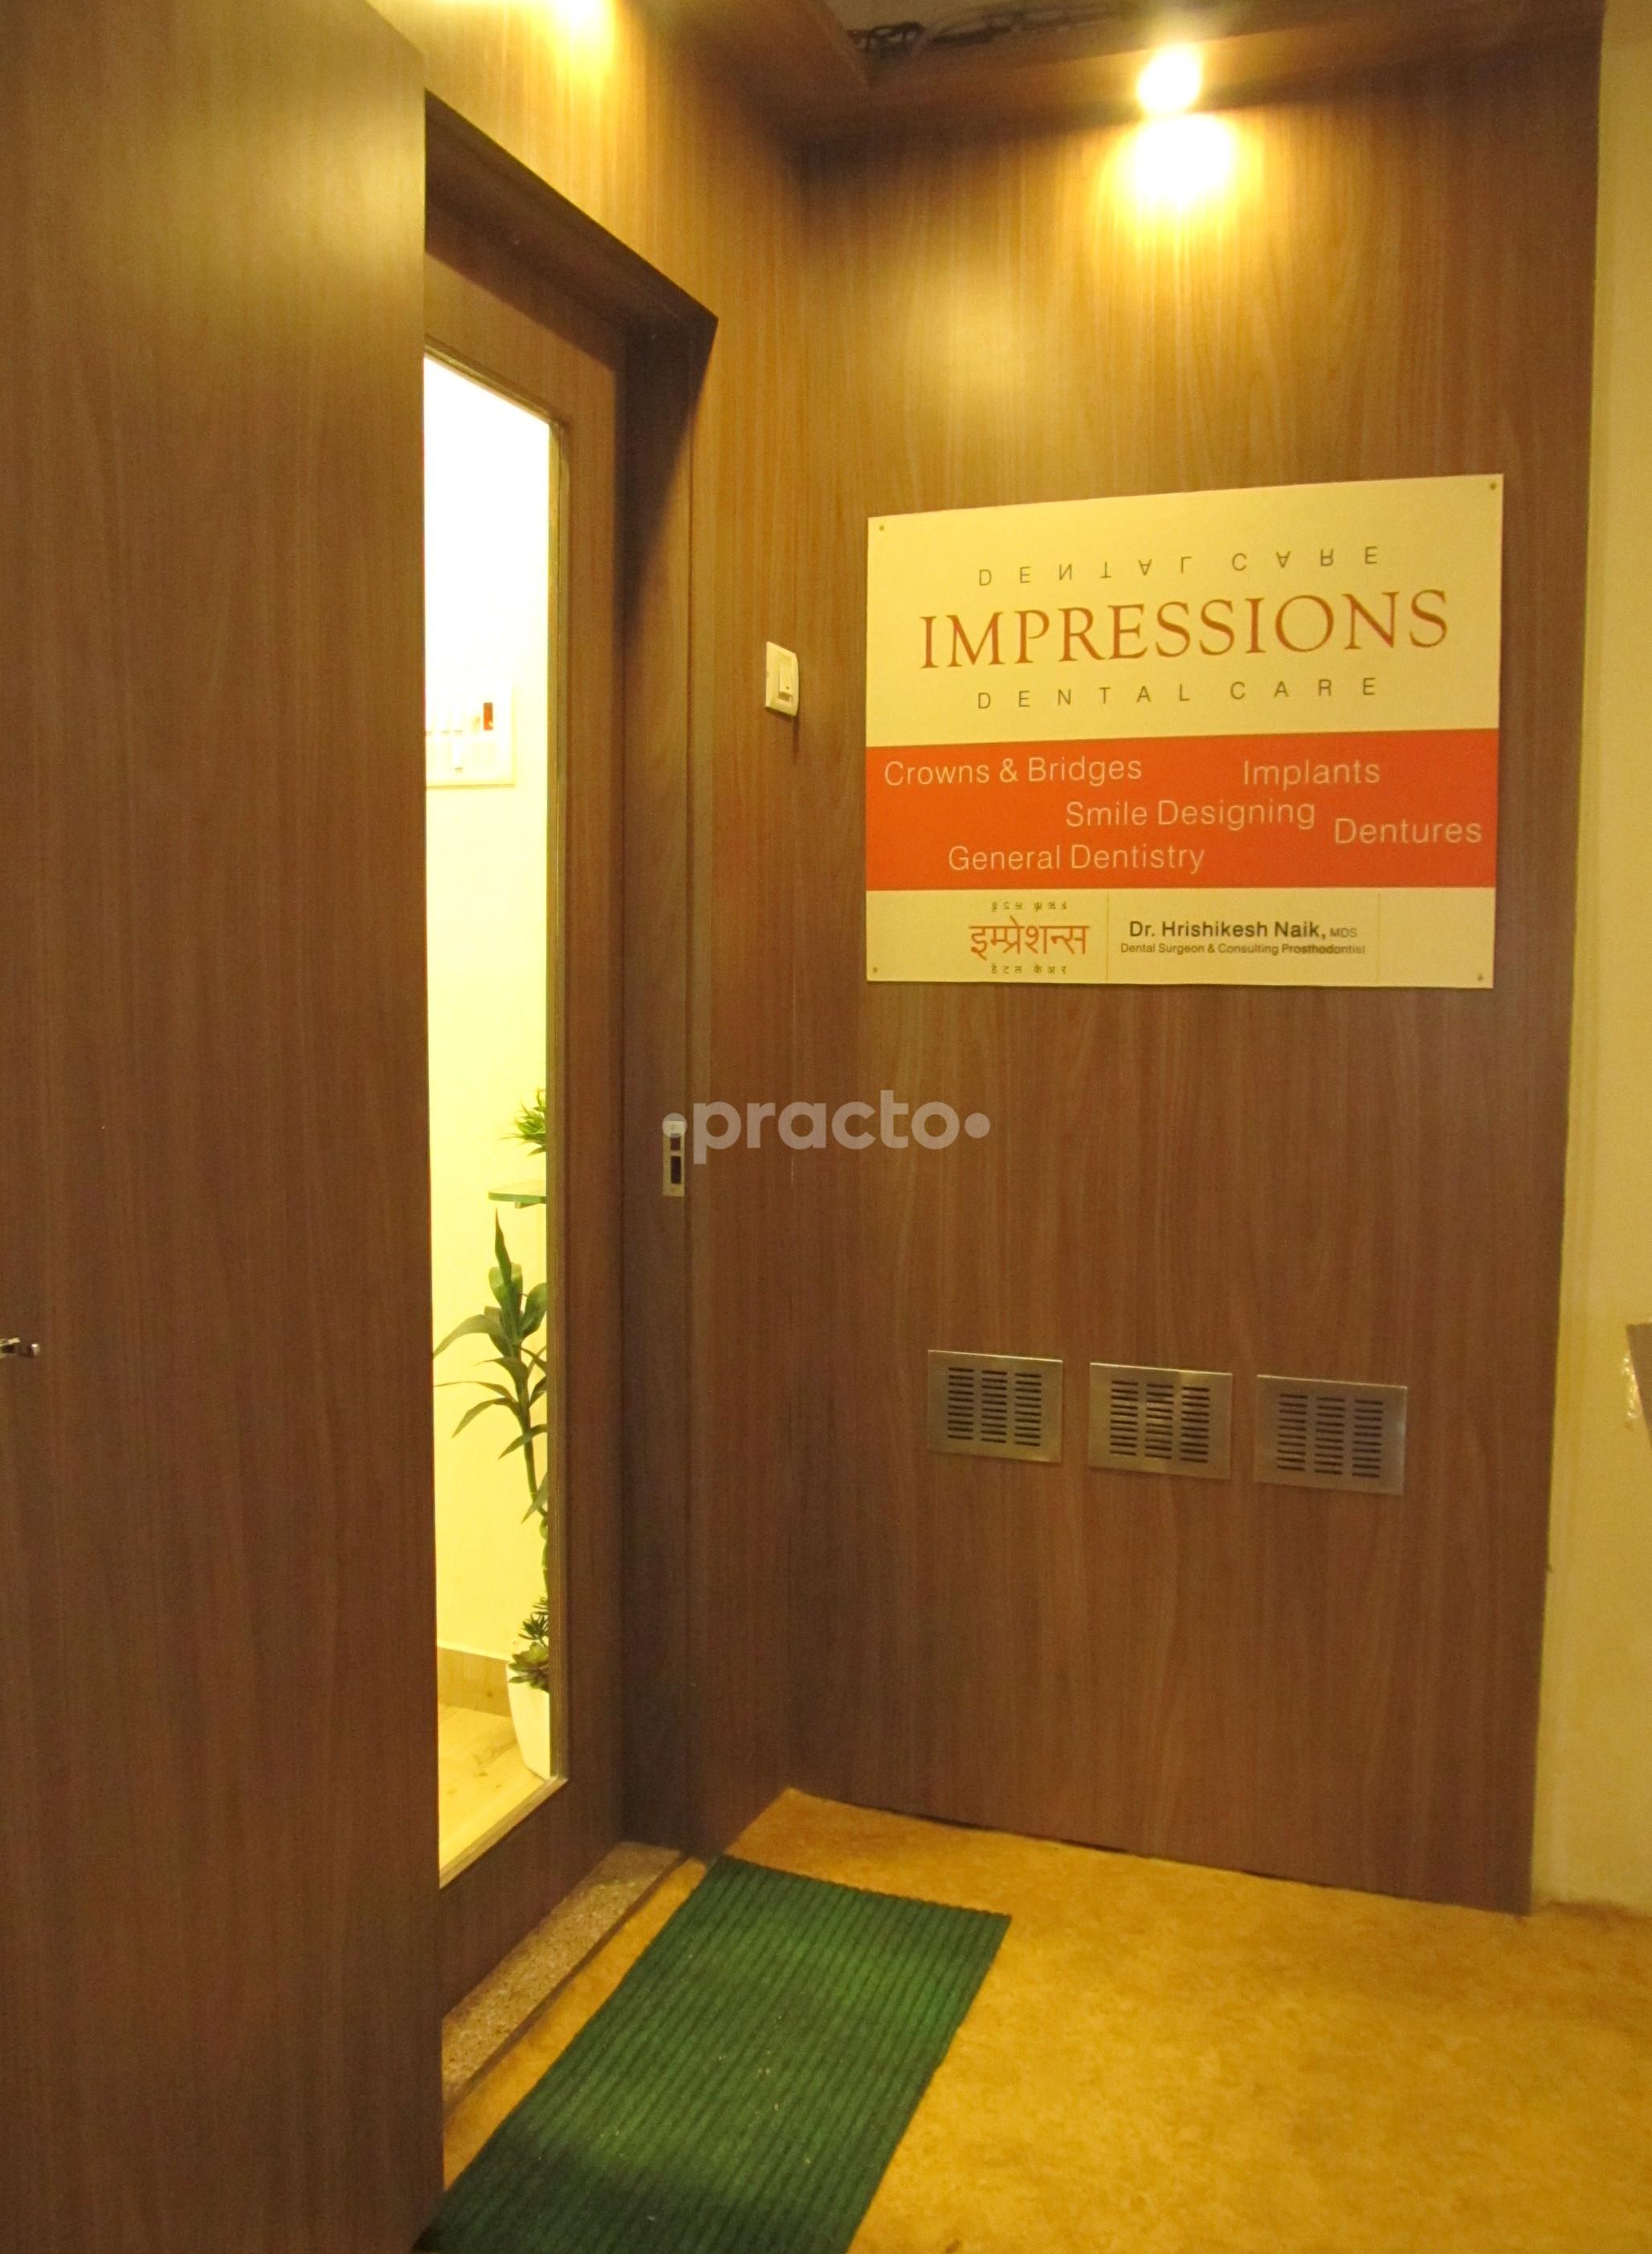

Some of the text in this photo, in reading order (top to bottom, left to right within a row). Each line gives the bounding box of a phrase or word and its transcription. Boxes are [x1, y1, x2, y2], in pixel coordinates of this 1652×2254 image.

[920, 589, 1448, 669] IMPRESSIONS
[977, 676, 1376, 709] DENTAL CARE
[884, 755, 1142, 787] Crowns & Bridges
[1243, 759, 1381, 791] Implants
[1066, 799, 1315, 831] Smile Designing
[1334, 817, 1483, 844] Dentures
[948, 843, 1205, 875] General Dentistry
[968, 915, 1091, 961] इम्प्रेशन्स
[1129, 920, 1358, 941] Dr. Hrishikesh Naik, MDS
[1120, 942, 1366, 957] Dental Surgeon & Consulting Prosthodontist
